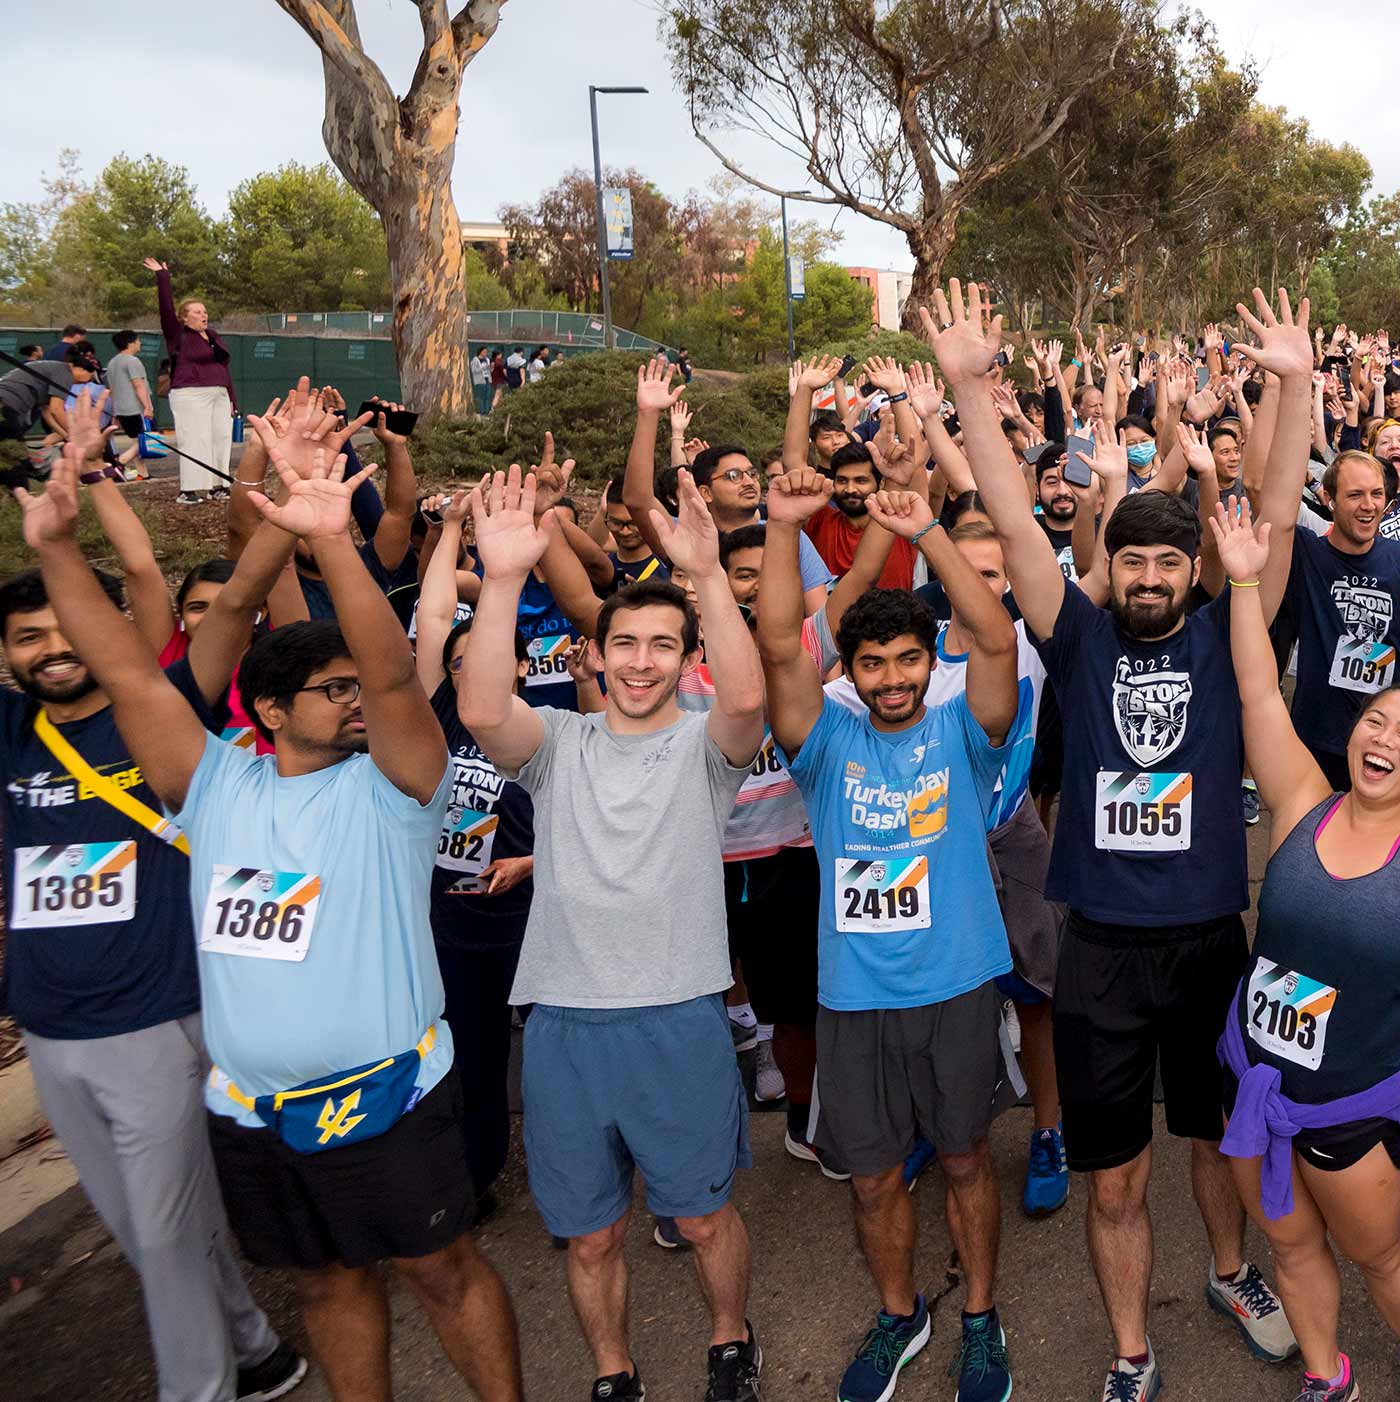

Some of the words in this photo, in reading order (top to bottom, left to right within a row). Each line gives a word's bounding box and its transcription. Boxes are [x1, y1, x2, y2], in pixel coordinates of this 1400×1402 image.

[1343, 575, 1378, 588] 2022
[537, 618, 559, 634] do
[1347, 604, 1374, 624] 5K
[1341, 656, 1387, 687] 1031
[27, 785, 76, 807] THE
[844, 777, 912, 811] Turkey
[913, 767, 950, 799] Day
[851, 804, 907, 830] Dash
[1103, 801, 1182, 837] 1055
[27, 871, 123, 912] 1385
[843, 886, 919, 919] 2419
[215, 898, 306, 943] 1386
[1252, 990, 1317, 1051] 2103
